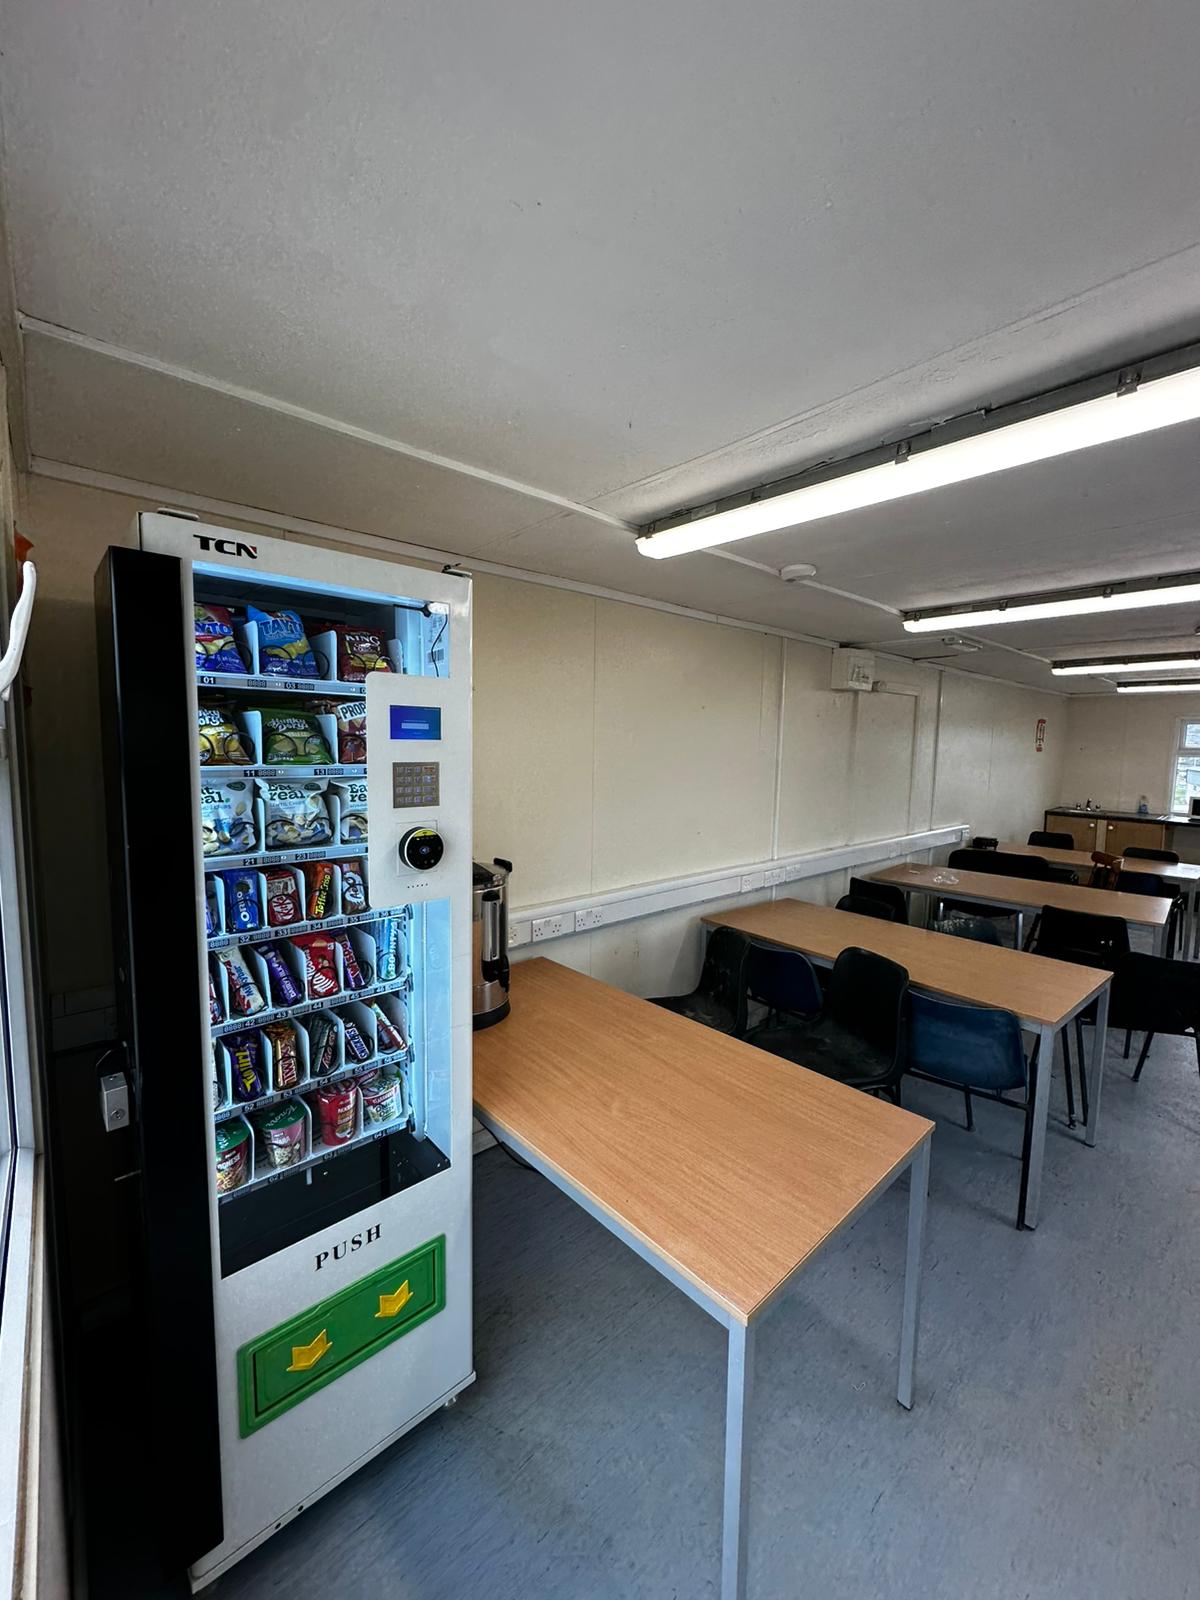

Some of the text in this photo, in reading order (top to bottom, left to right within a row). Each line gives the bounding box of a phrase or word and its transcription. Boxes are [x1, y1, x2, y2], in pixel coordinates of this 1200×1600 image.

[193, 534, 257, 559] TCN
[195, 622, 233, 636] YTO
[259, 618, 304, 636] TAYT
[345, 634, 381, 646] KING
[203, 676, 215, 684] 01
[348, 783, 367, 793] Ea
[350, 793, 367, 802] re
[315, 890, 328, 915] Toffee
[277, 1011, 287, 1019] 43
[245, 1019, 256, 1027] 42
[346, 1028, 369, 1059] SNICKERS
[244, 1104, 255, 1112] 52
[265, 1105, 298, 1127] Knorr
[314, 1224, 382, 1272] PUSH
